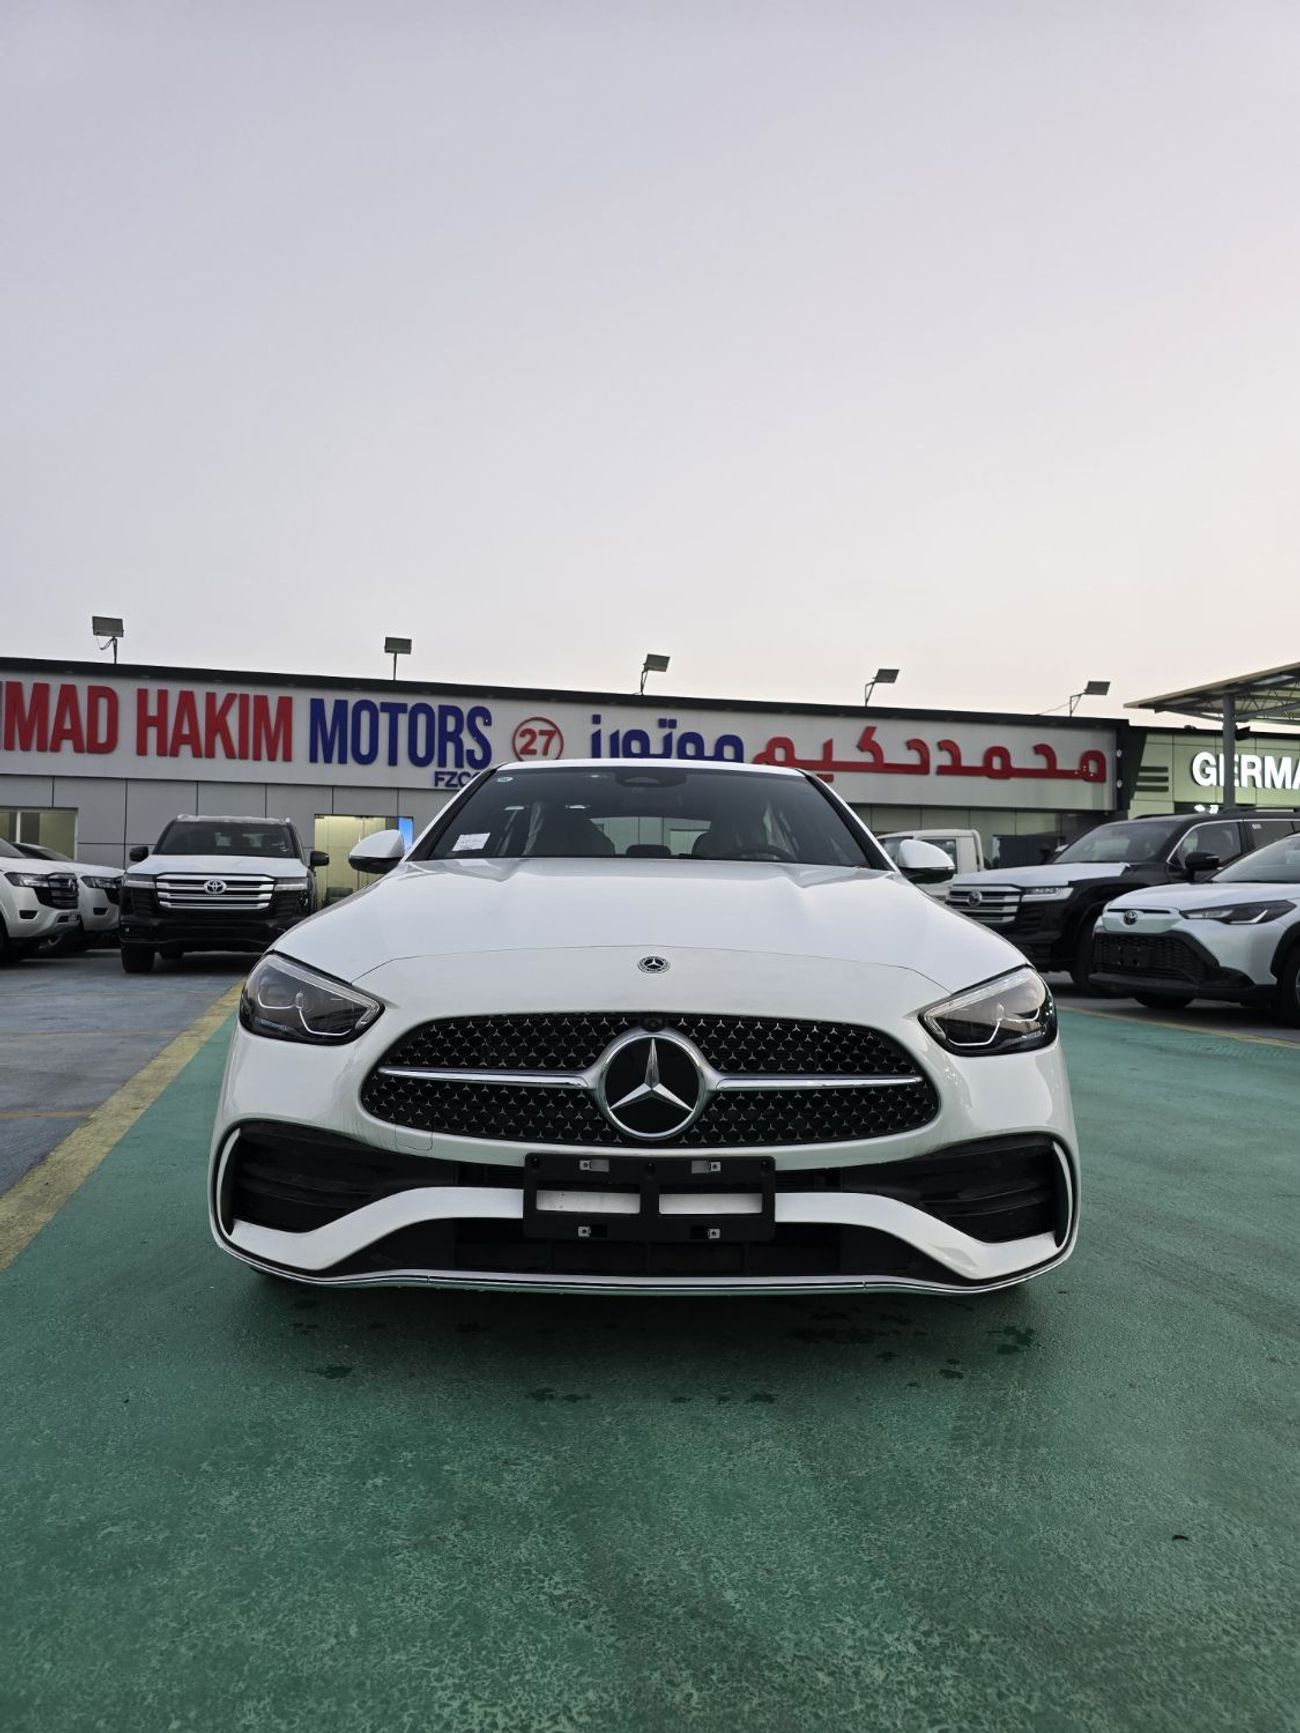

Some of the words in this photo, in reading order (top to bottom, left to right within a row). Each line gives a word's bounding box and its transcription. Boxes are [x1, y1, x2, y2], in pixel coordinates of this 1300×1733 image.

[0, 681, 119, 755] MAD
[136, 688, 293, 762] HAKIM
[309, 698, 492, 770] MOTORS
[519, 728, 556, 756] 27
[753, 726, 930, 783] حكيم
[936, 739, 1106, 783] محمد
[434, 771, 481, 788] FZC
